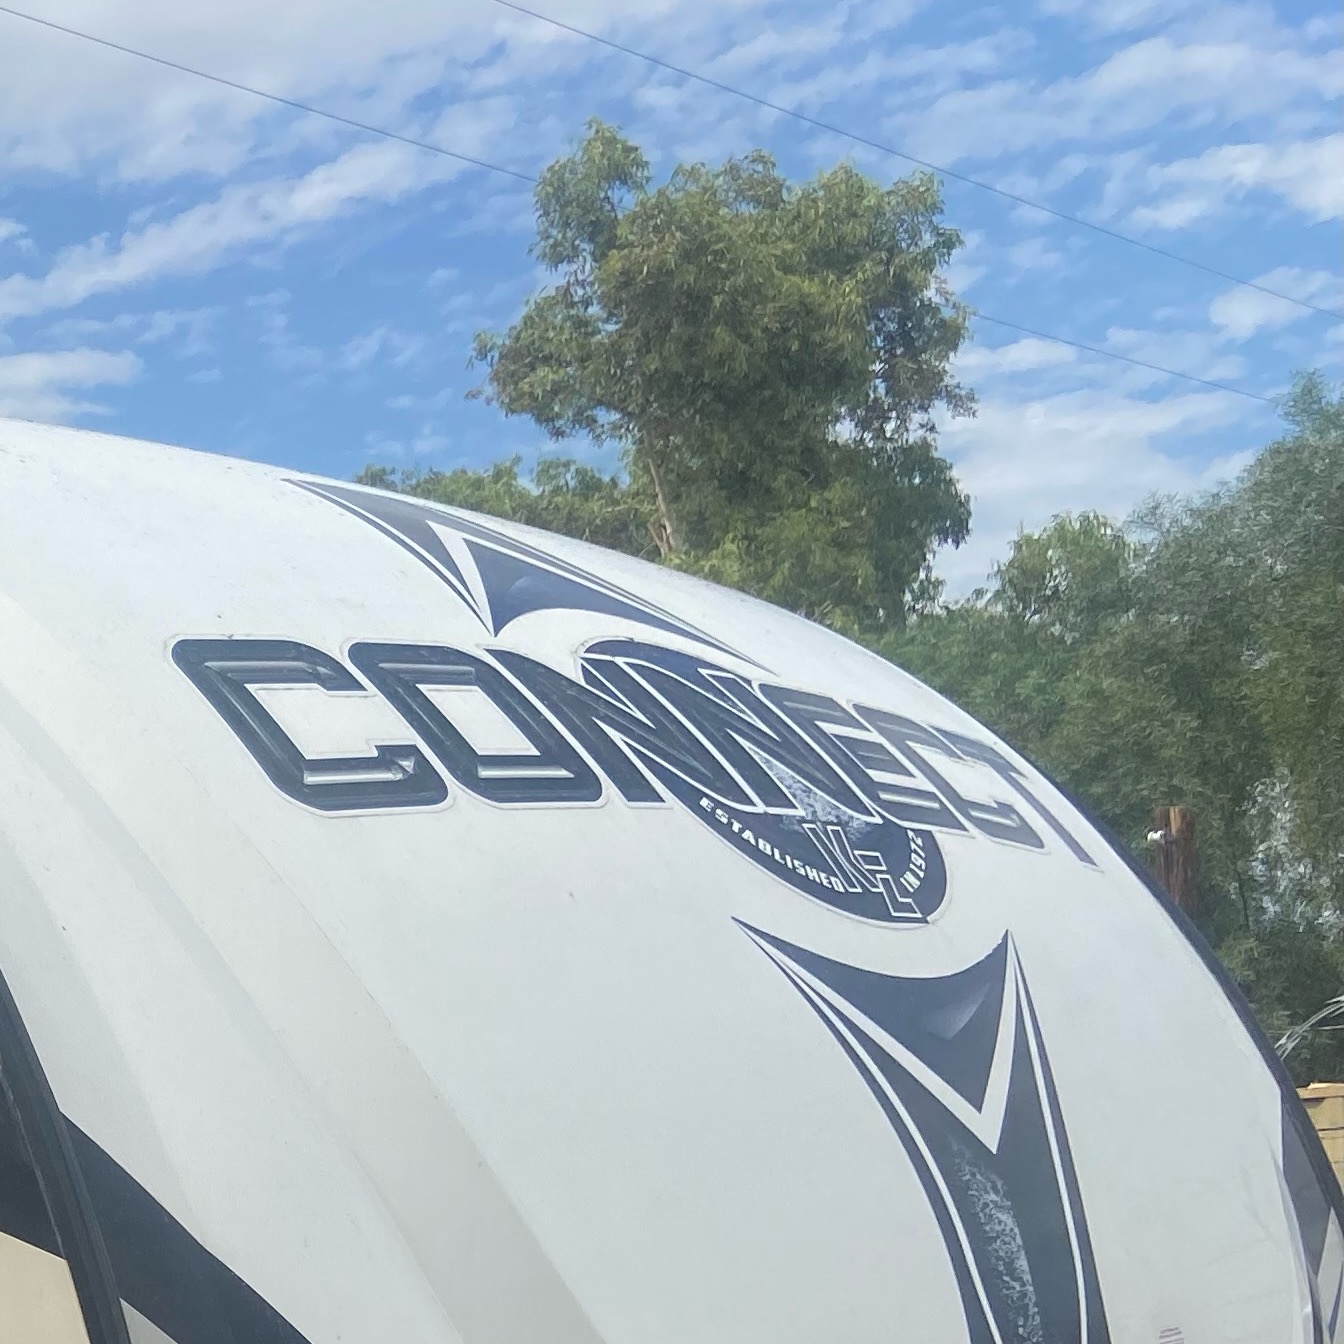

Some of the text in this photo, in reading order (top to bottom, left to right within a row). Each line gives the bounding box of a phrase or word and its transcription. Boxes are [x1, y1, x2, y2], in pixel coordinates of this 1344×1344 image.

[170, 638, 1100, 868] CONNECT
[700, 797, 845, 893] ESTABLISHED
[907, 829, 926, 879] 1972
